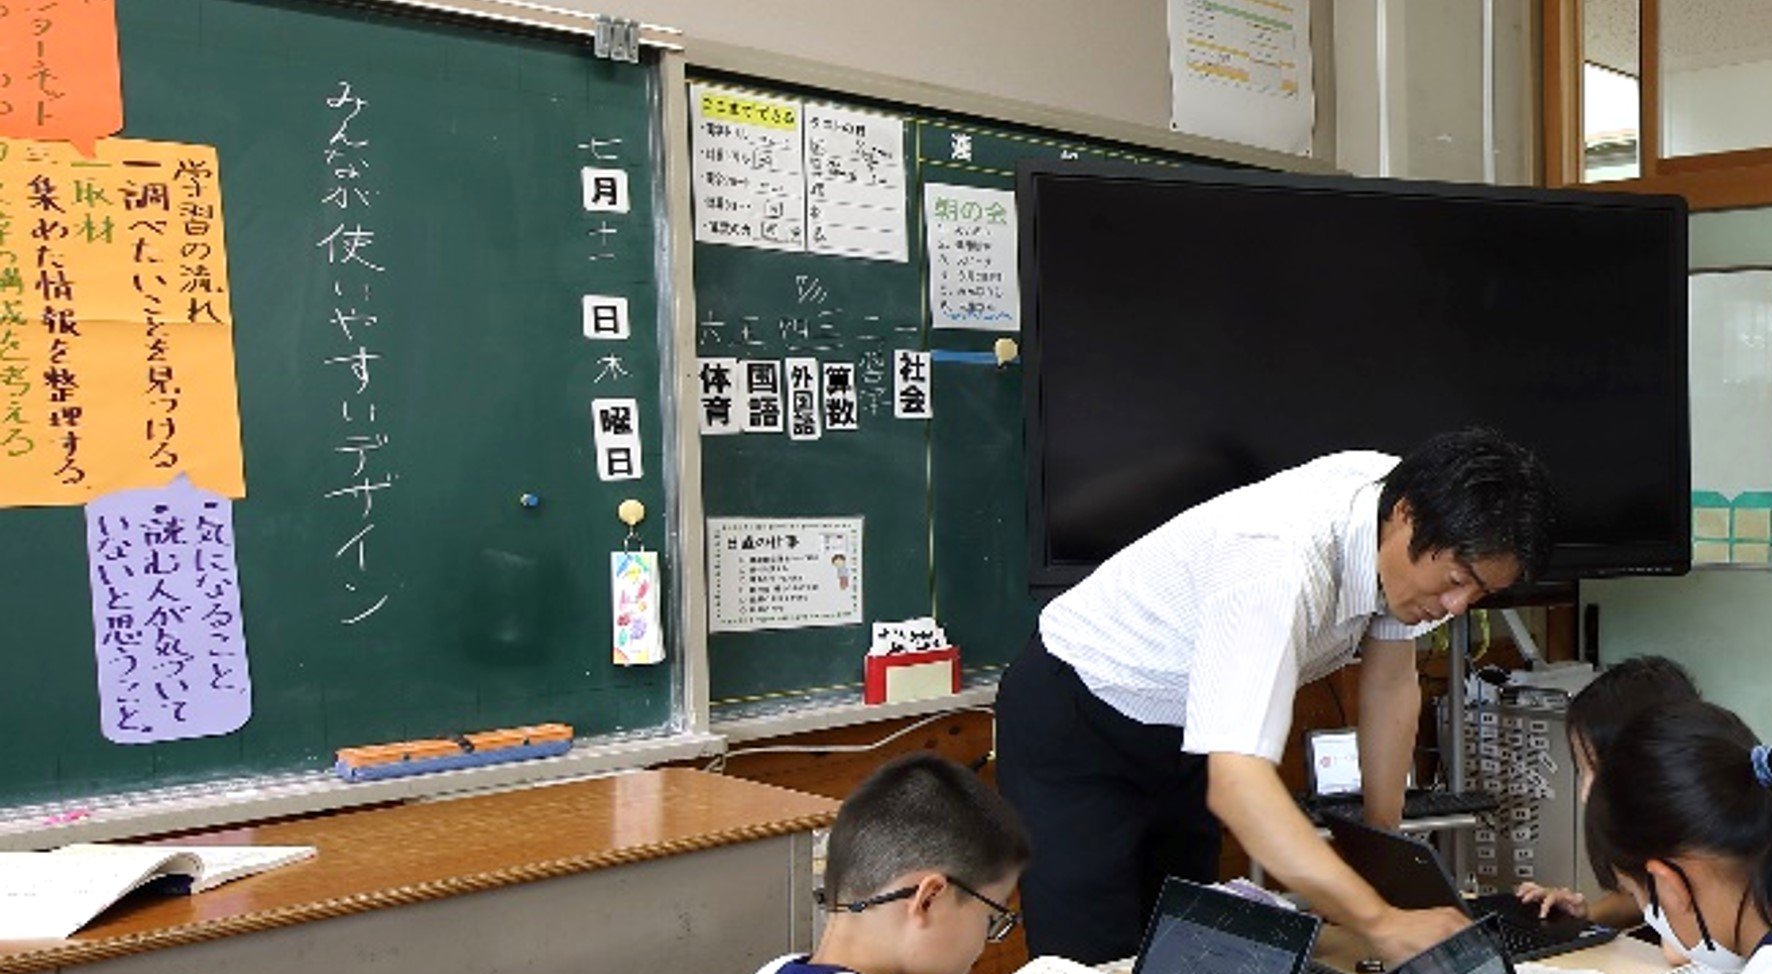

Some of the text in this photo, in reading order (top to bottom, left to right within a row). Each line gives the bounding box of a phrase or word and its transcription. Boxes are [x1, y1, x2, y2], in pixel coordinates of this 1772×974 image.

[591, 176, 618, 206] 月
[934, 197, 1008, 225] 朝の会
[172, 158, 225, 325] 学習の流れ
[592, 306, 620, 334] 日
[317, 80, 396, 625] みんなが使いやすいデザイン
[593, 352, 629, 383] 木
[899, 351, 927, 413] 社会
[700, 362, 732, 427] 体育
[746, 363, 780, 427] 国語
[790, 364, 816, 436] 外国語
[825, 365, 856, 427] 算数
[599, 405, 635, 477] 曜日
